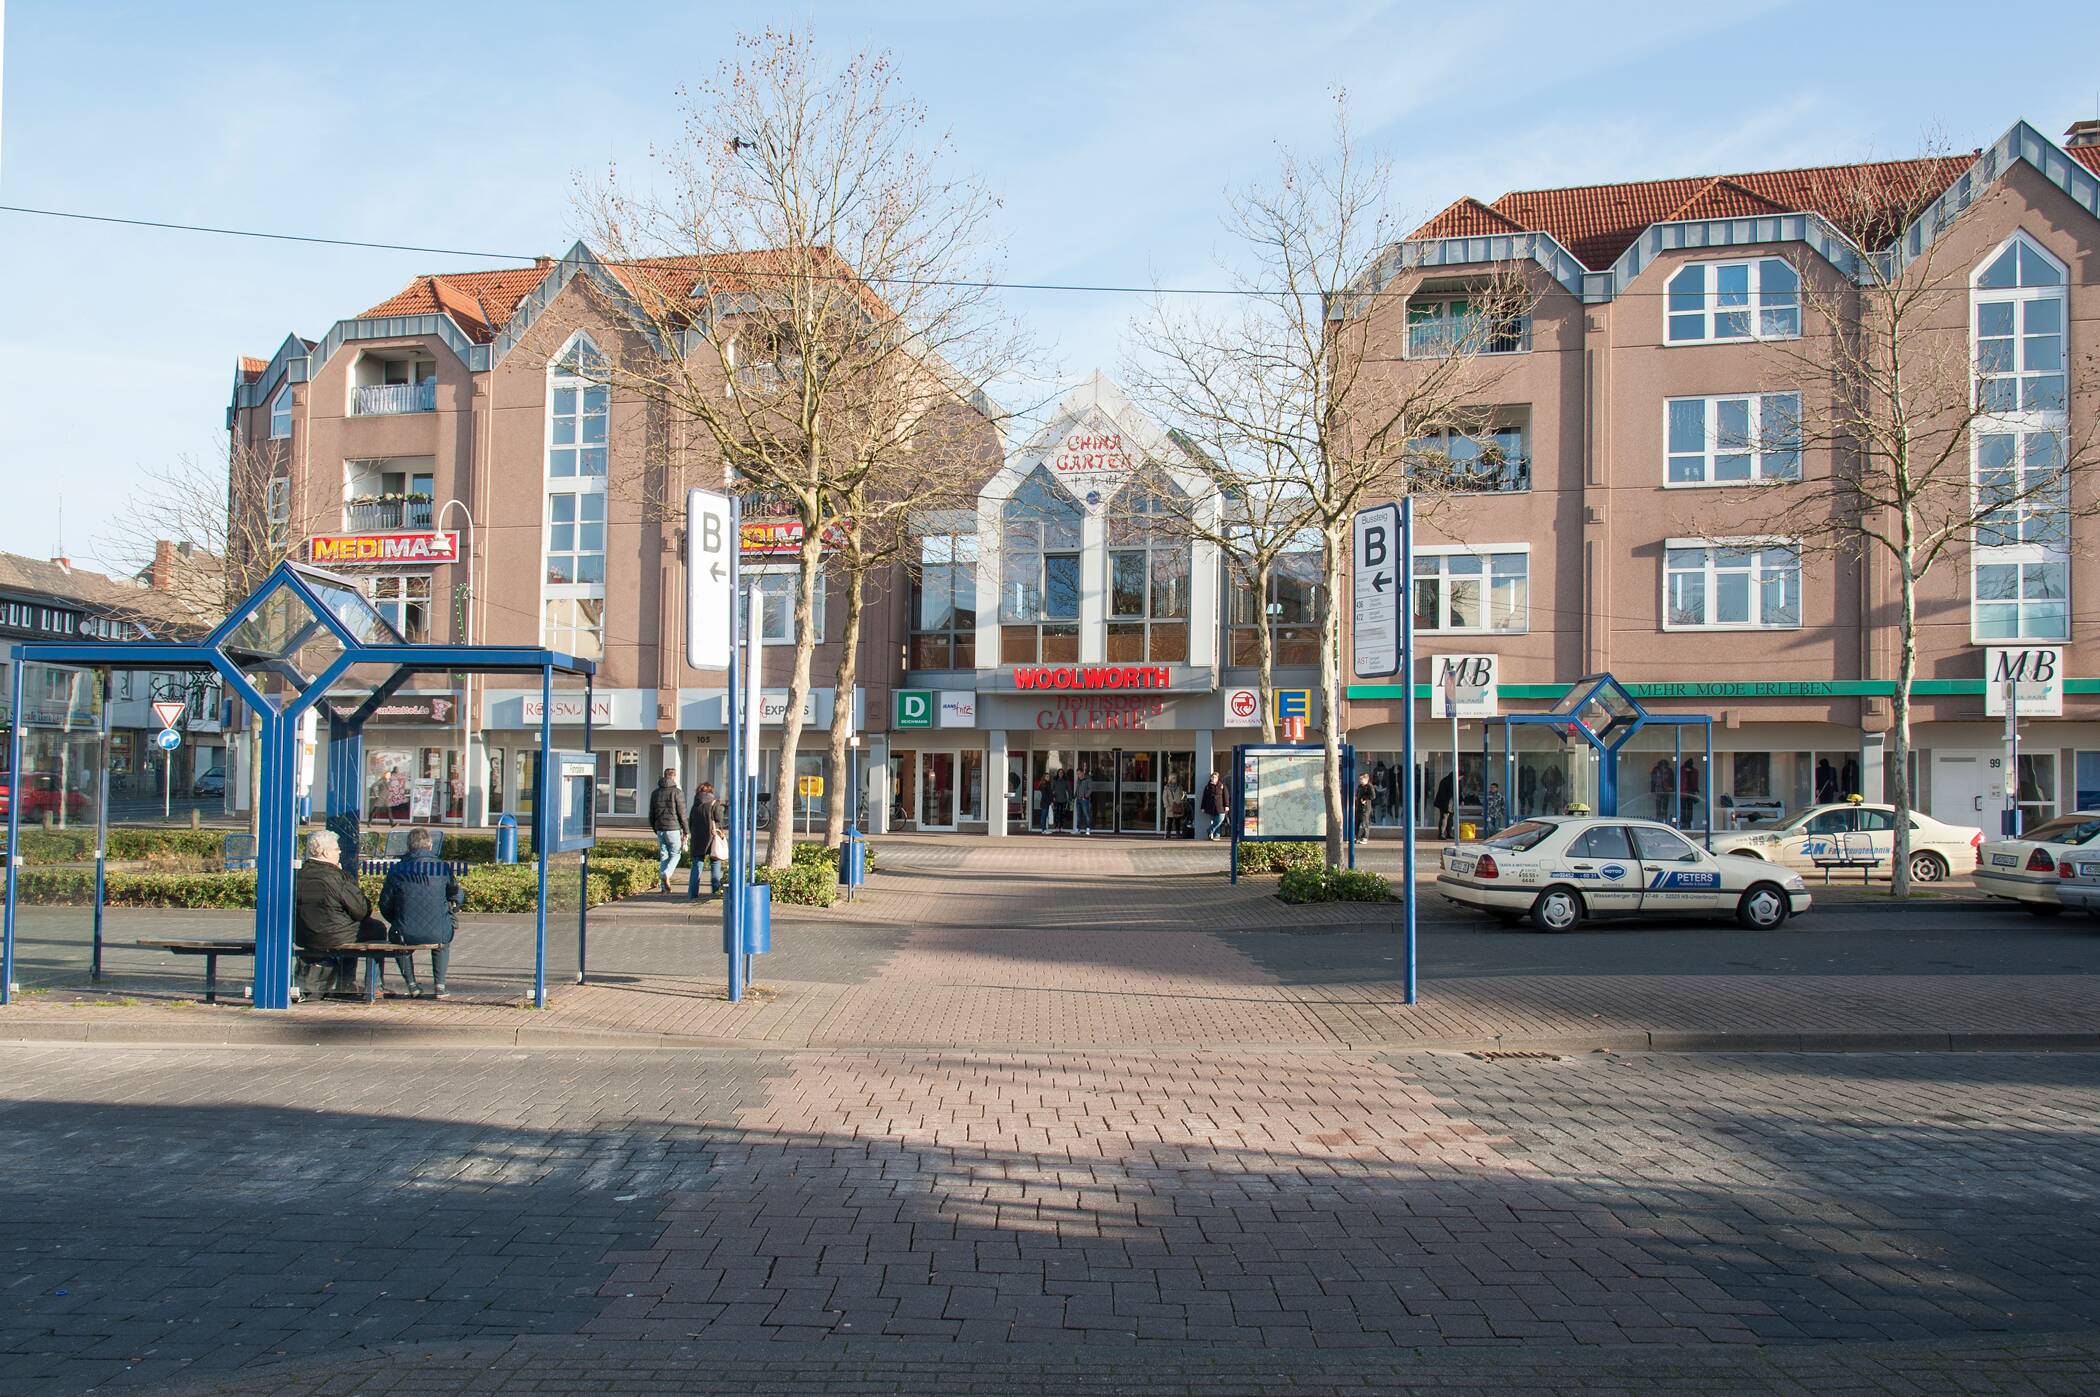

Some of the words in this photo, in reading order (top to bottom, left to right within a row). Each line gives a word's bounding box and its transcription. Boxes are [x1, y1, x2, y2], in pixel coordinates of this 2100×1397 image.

[1068, 434, 1121, 452] CHINA
[1056, 453, 1132, 471] GARTEN
[1361, 512, 1388, 525] Bussteig
[703, 511, 722, 553] B
[1364, 526, 1387, 567] B
[1013, 666, 1172, 689] WOOLWORTH
[1638, 683, 1687, 696] MEHR
[1696, 682, 1746, 696] MODE
[1755, 681, 1832, 696] ERLEBEN
[526, 702, 609, 715] ROSMANN
[765, 705, 809, 716] EXPS
[905, 696, 926, 718] D
[1036, 710, 1148, 730] GALERIE
[697, 736, 711, 744] 105
[1990, 758, 2001, 769] 99
[1800, 843, 1826, 855] 2K
[1677, 873, 1713, 882] PETERS
